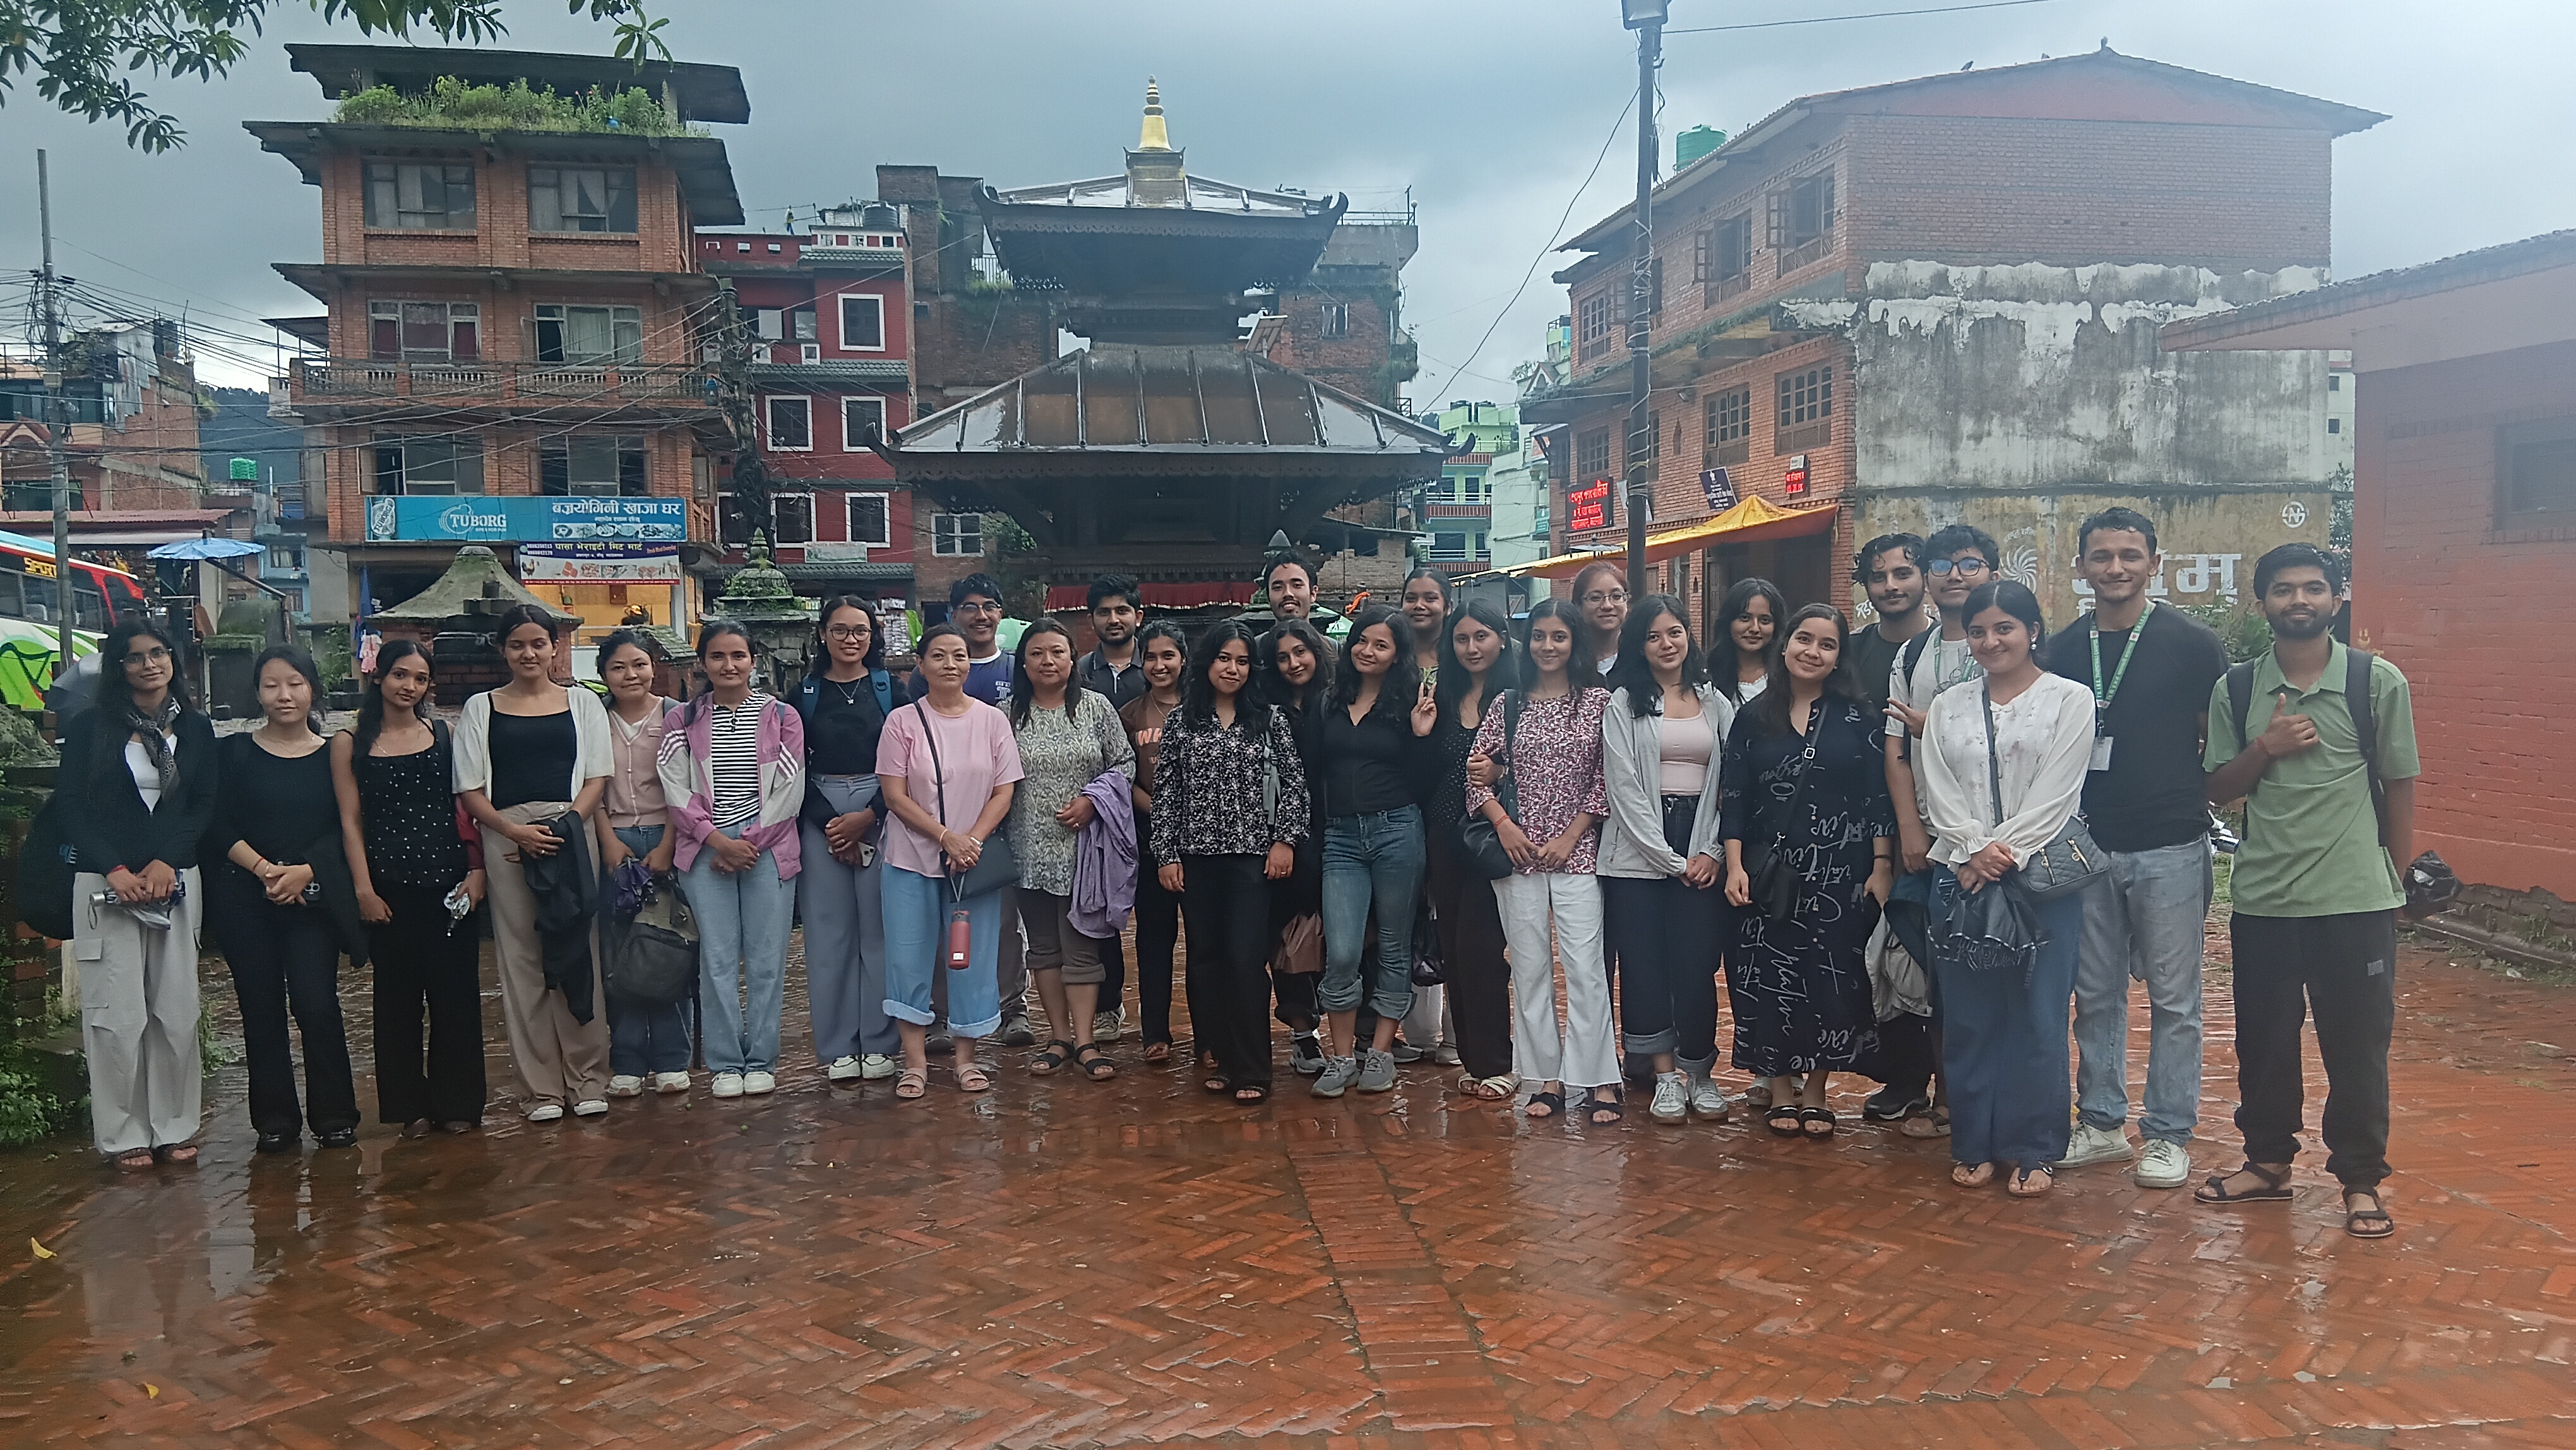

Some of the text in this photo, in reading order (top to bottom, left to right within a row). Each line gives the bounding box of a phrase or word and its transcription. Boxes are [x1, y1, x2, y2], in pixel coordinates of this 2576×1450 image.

[623, 503, 658, 515] खाजा
[661, 503, 681, 515] घर
[450, 513, 506, 528] TUBORG
